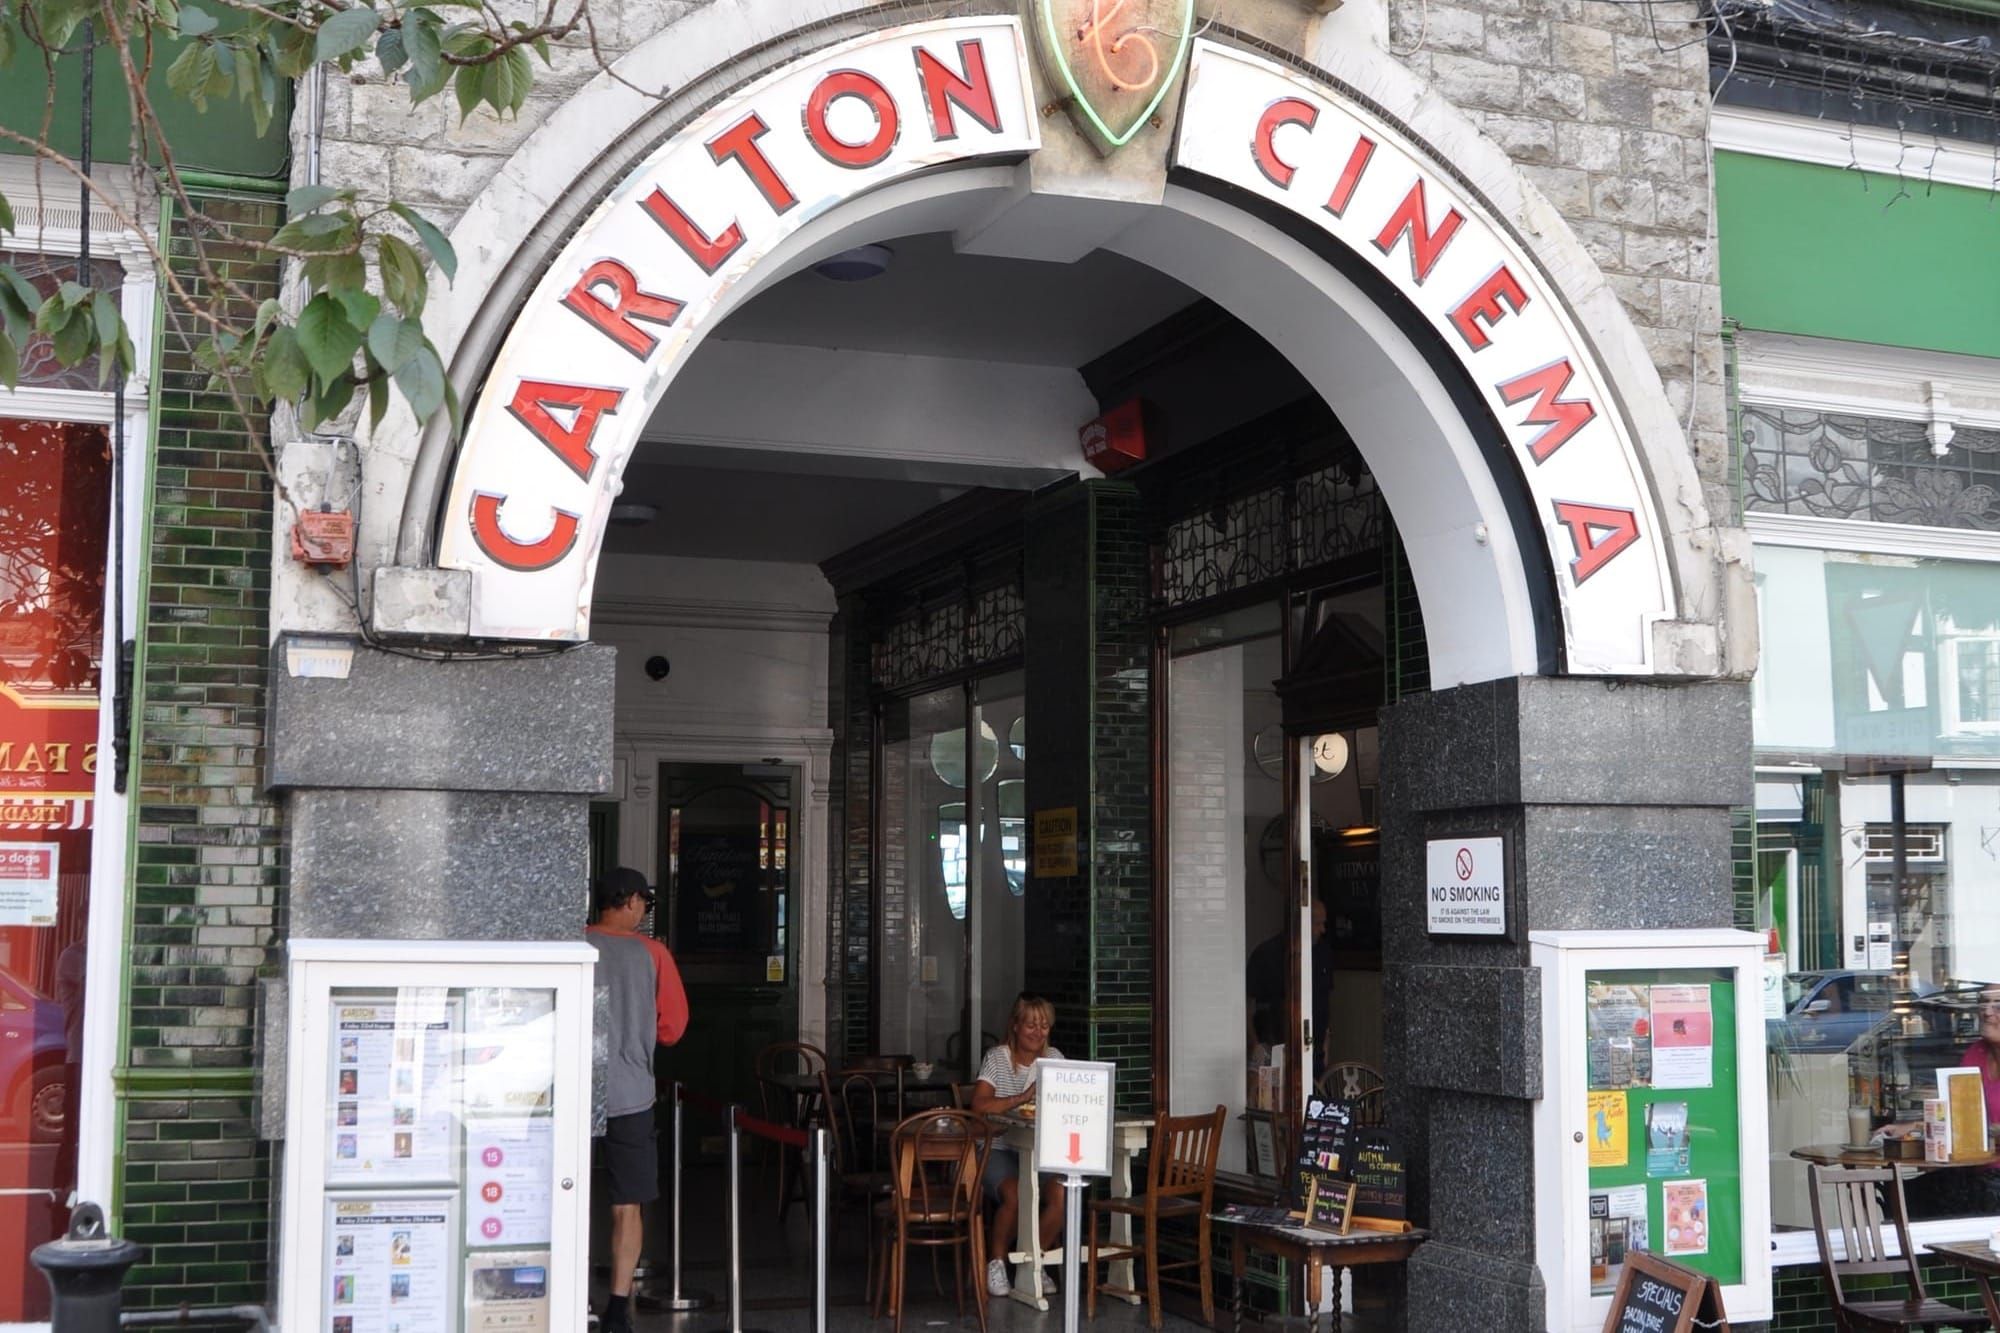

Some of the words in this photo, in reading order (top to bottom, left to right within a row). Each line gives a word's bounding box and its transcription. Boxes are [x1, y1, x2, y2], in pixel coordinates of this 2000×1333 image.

[469, 38, 1003, 573] CARLTON
[1250, 96, 1641, 587] CINEMA
[9, 853, 41, 866] dogs
[1431, 886, 1447, 902] NO
[1449, 886, 1500, 902] SMOKING
[1056, 1072, 1097, 1085] PLEASE
[1047, 1092, 1080, 1105] MIND
[1083, 1094, 1105, 1106] THE
[1062, 1114, 1089, 1126] STEP
[487, 1151, 498, 1162] 15
[486, 1187, 497, 1197] 18
[486, 1223, 497, 1233] 15
[1637, 1281, 1682, 1315] SPECIALS
